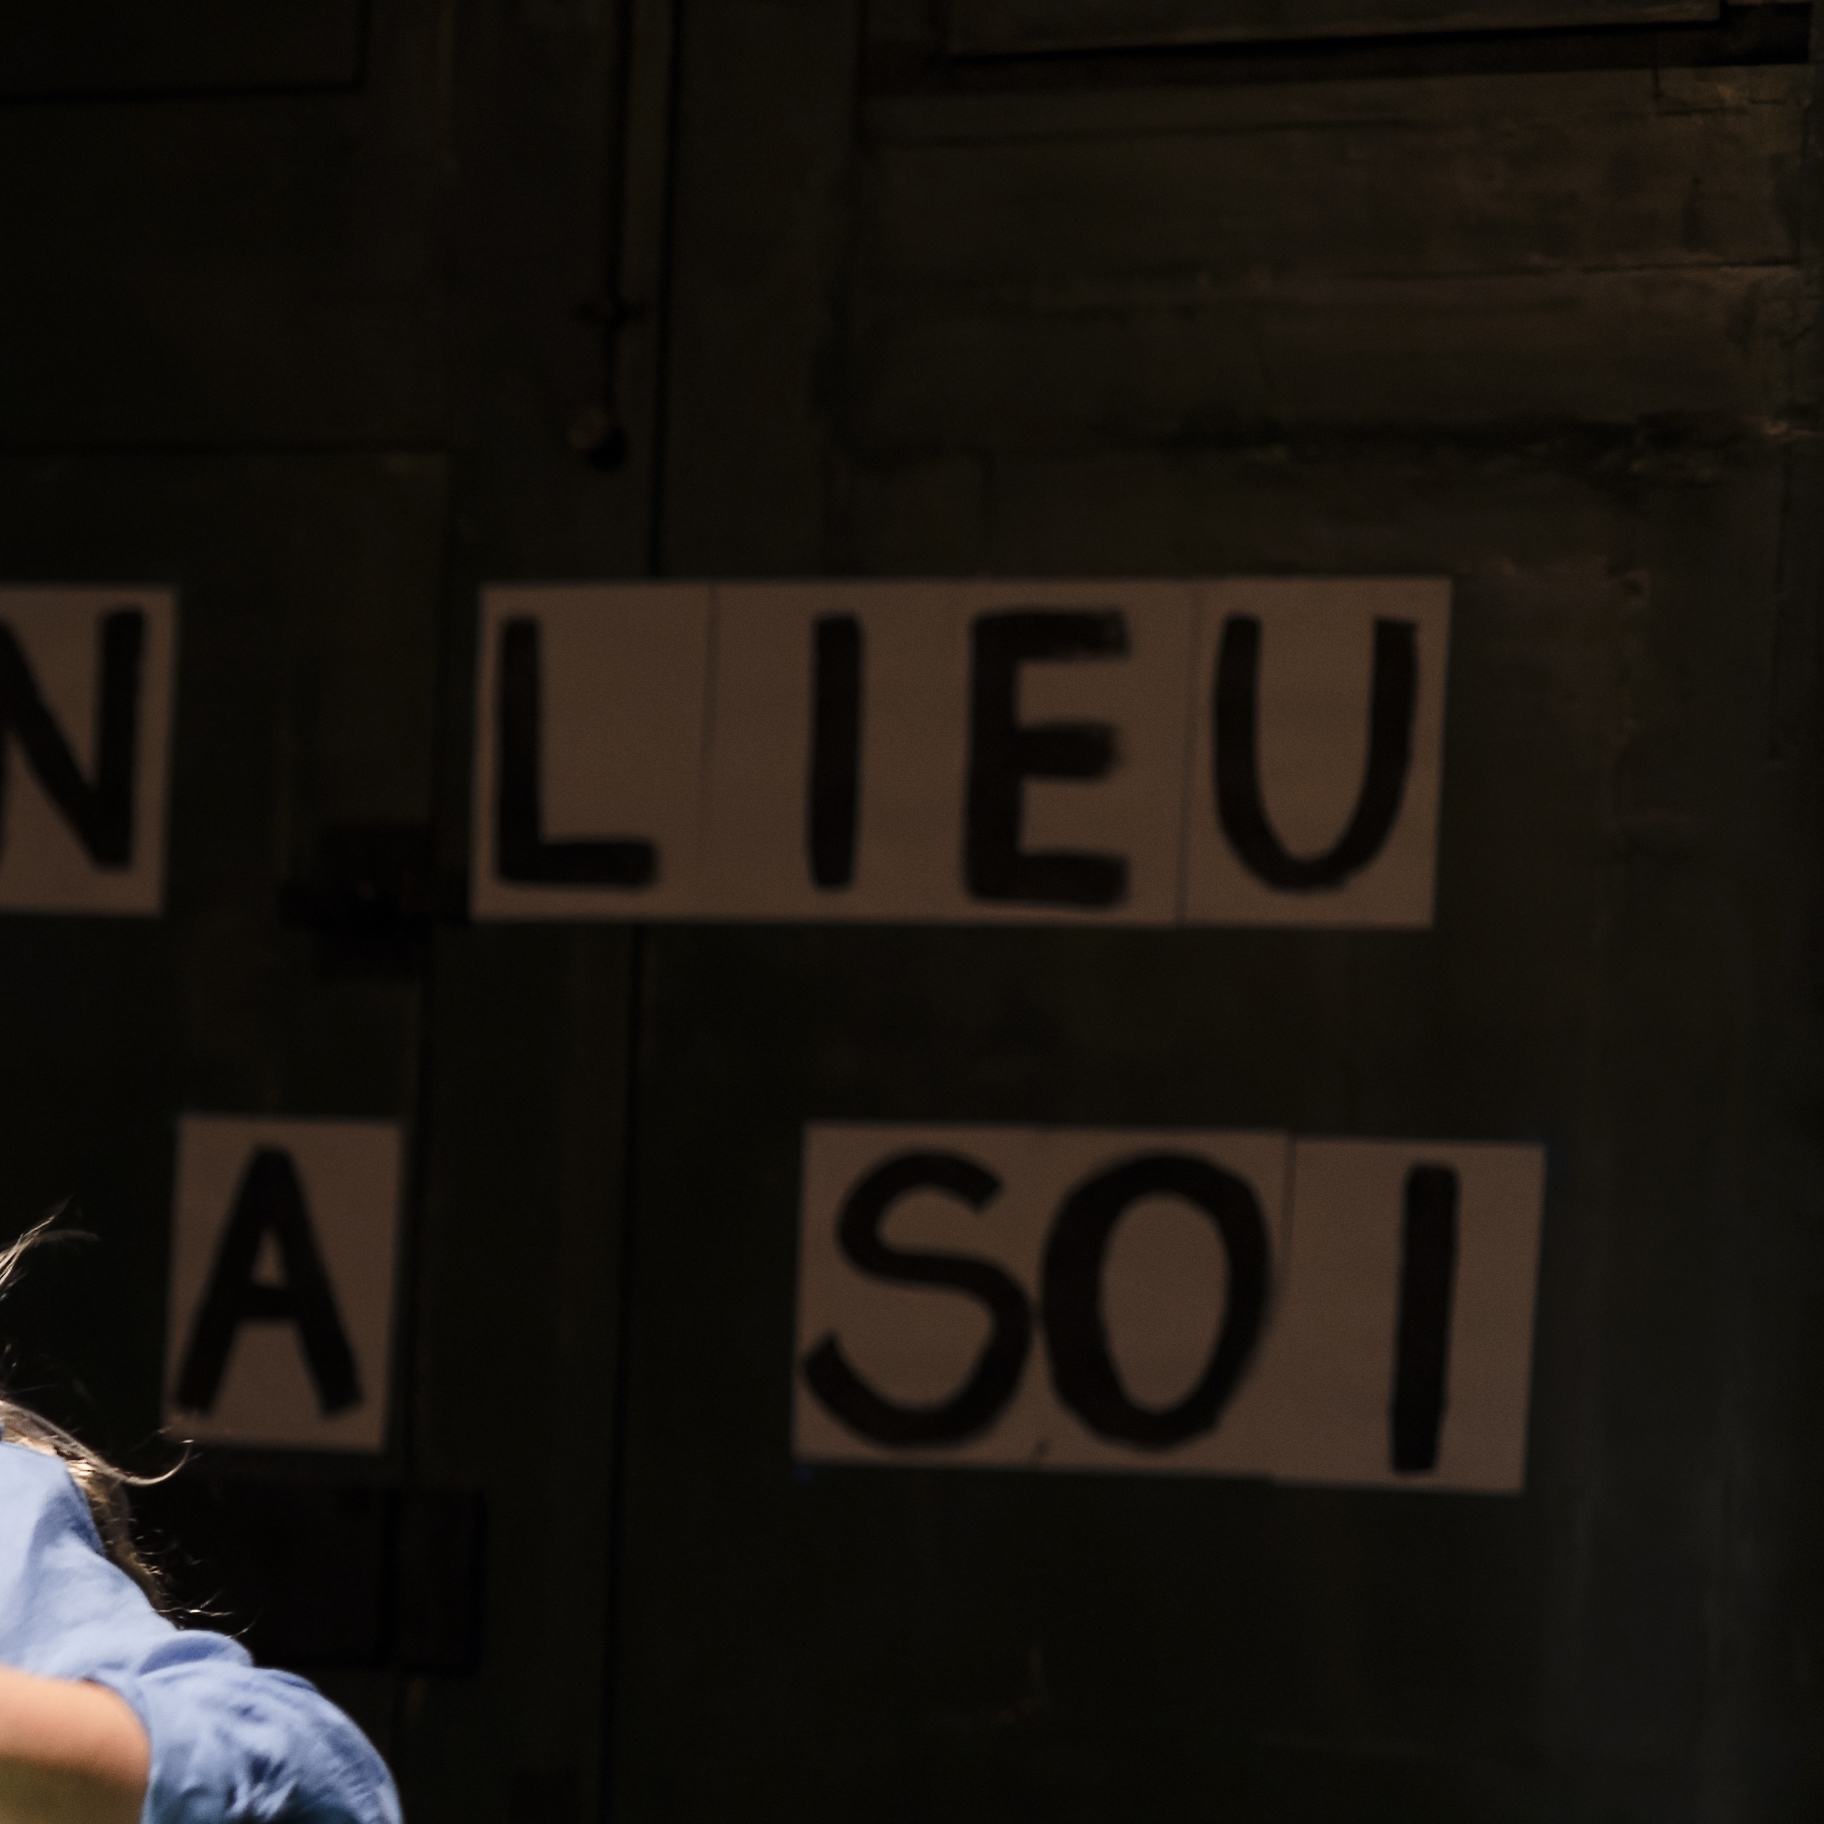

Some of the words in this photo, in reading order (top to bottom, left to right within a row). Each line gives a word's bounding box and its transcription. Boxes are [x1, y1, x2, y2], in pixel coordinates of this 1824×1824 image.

[492, 608, 1420, 907] LIEU
[176, 1143, 366, 1418] A
[802, 1150, 1461, 1475] SOI
